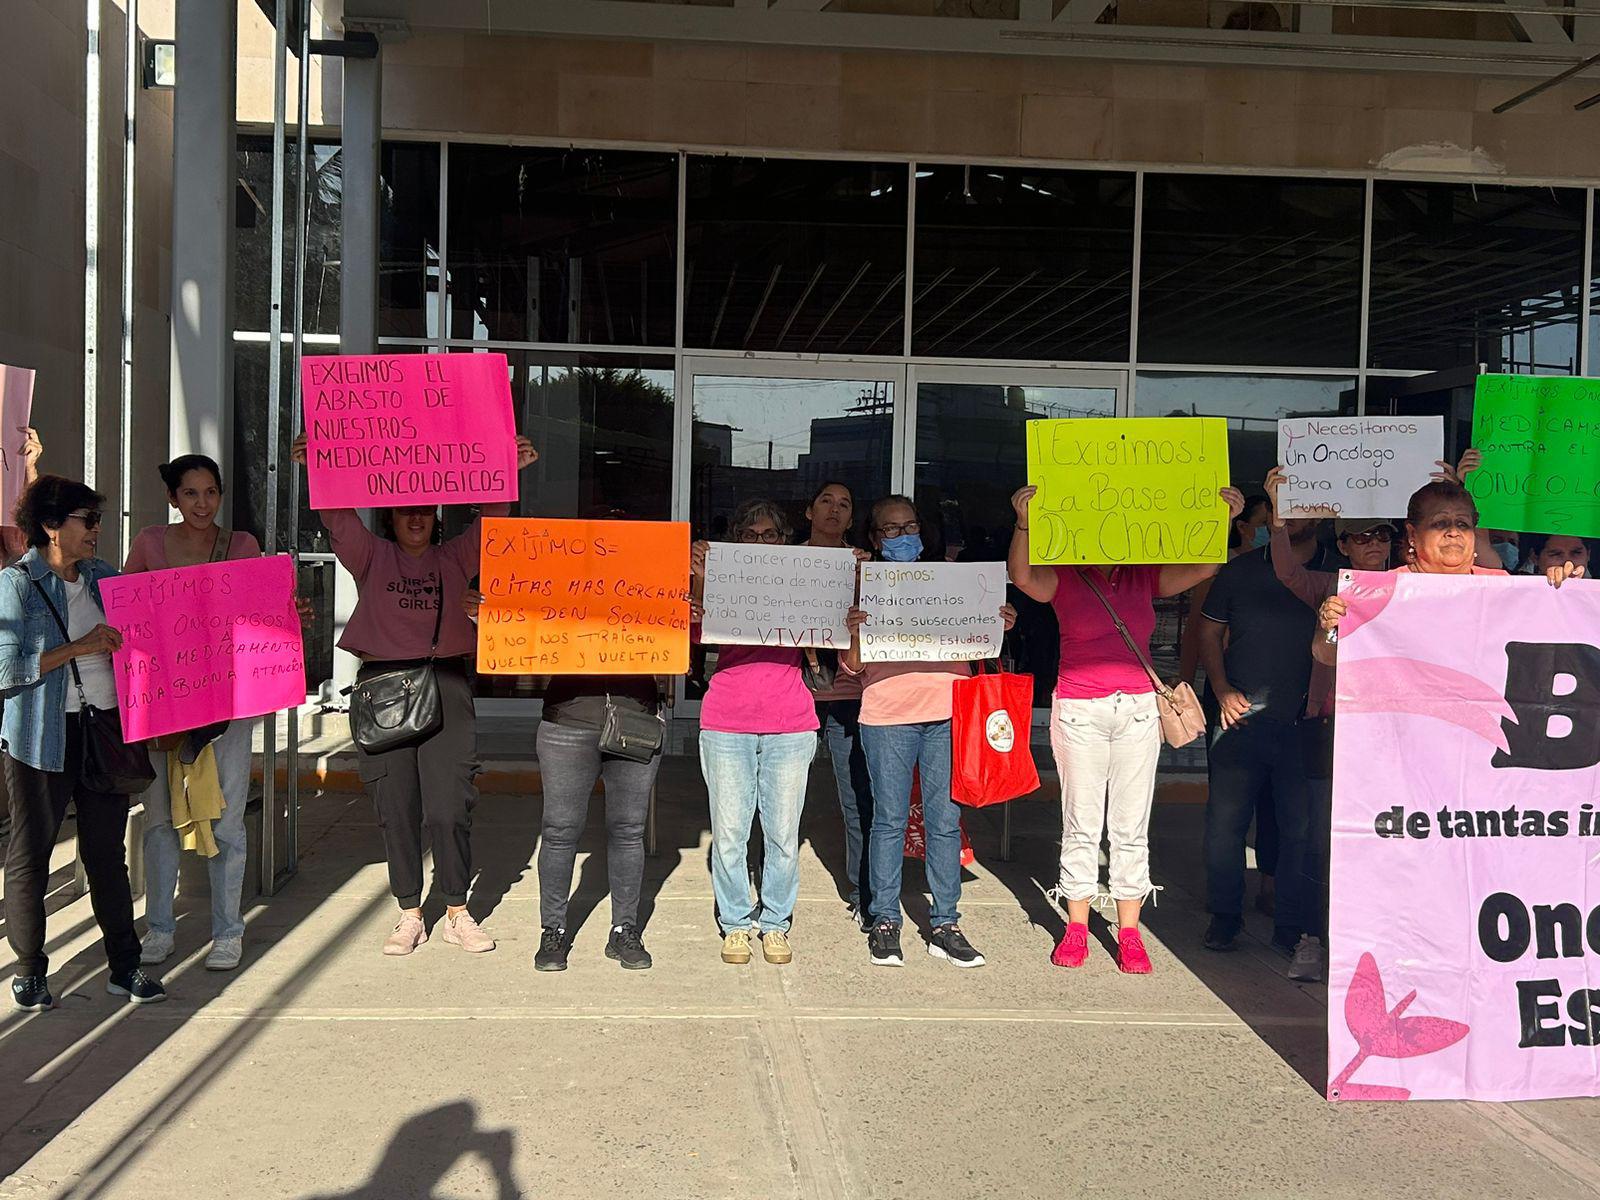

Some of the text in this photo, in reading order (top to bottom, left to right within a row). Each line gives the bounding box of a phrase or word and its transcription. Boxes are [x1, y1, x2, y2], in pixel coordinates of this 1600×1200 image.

[309, 360, 451, 386] EXIGIMOS EL
[315, 387, 455, 411] ABASTO DE
[313, 416, 418, 441] NUESTROS
[1307, 420, 1418, 437] Necesitamos
[1032, 417, 1207, 466] ¡Exigimos!
[1475, 438, 1590, 456] CONTRA EL
[316, 442, 486, 469] MEDICAMENTOS
[1285, 450, 1307, 467] Un
[367, 470, 506, 496] ONCOLOGICOS
[1288, 469, 1389, 491] Para cada
[1037, 471, 1219, 513] La Base del
[1036, 511, 1223, 562] Dr. Chavez
[708, 546, 724, 562] El
[489, 573, 552, 597] CITAS
[568, 579, 605, 596] MAS
[706, 569, 784, 586] Sentencia
[789, 573, 808, 587] de
[864, 566, 935, 588] Exigimos:
[399, 597, 440, 610] GIRLS
[705, 593, 725, 605] es
[730, 594, 758, 605] una
[486, 608, 526, 624] NOS
[540, 606, 588, 621] DEN
[780, 611, 796, 624] te
[863, 612, 997, 627] Citas subsecuentes
[120, 612, 284, 644] MAS ONCOLOGOS
[504, 637, 527, 647] NO
[540, 633, 569, 645] NOS
[577, 626, 656, 645] TRAIGAN
[757, 627, 834, 647] VIVIR
[940, 632, 990, 646] Estudios
[868, 648, 931, 661] Vacunas
[124, 656, 160, 678] MAS
[125, 685, 165, 710] UNA
[1490, 640, 1600, 770] B
[1374, 805, 1431, 839] de
[1438, 804, 1569, 838] tantas
